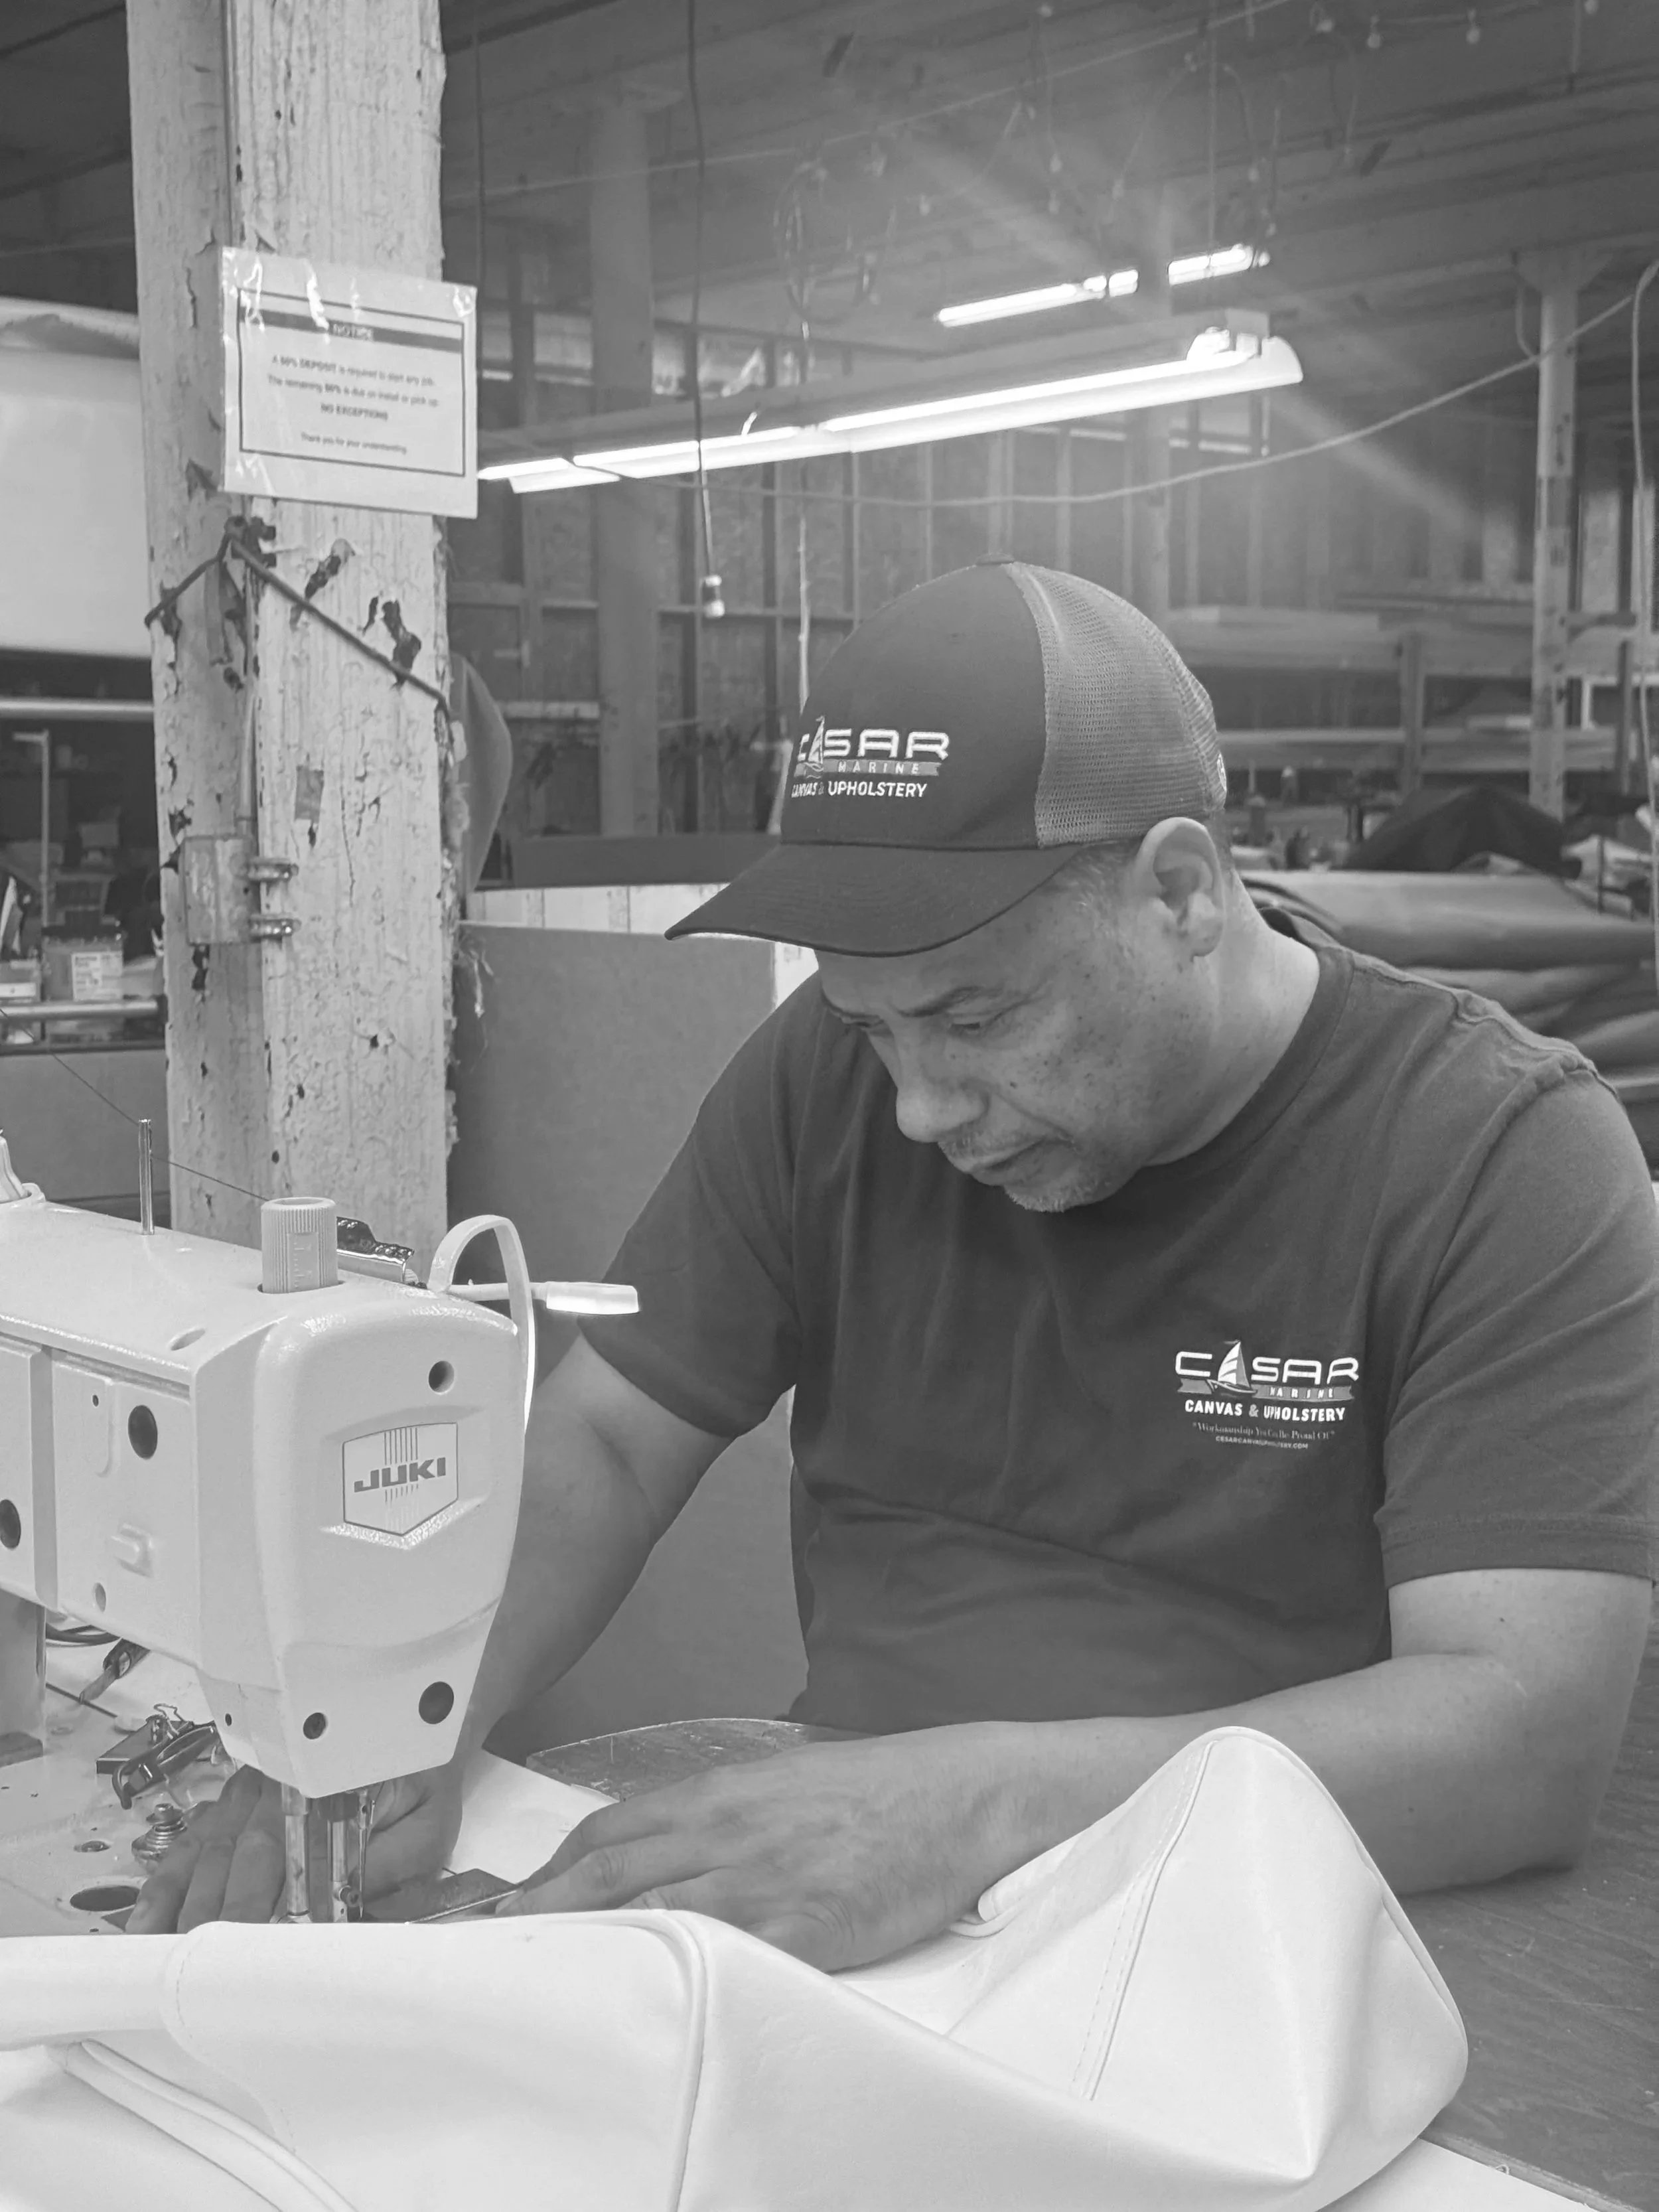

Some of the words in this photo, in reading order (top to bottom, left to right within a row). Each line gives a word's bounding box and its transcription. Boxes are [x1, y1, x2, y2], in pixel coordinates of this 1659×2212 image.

[838, 761, 920, 774] MARINE
[828, 780, 928, 798] UPHOLSTERY
[1269, 1386, 1334, 1399] MARINE
[1185, 1399, 1243, 1417] CANVAS
[1248, 1404, 1259, 1418] &
[1263, 1405, 1346, 1422] UPHOLSTERY
[354, 1457, 447, 1493] JUKI
